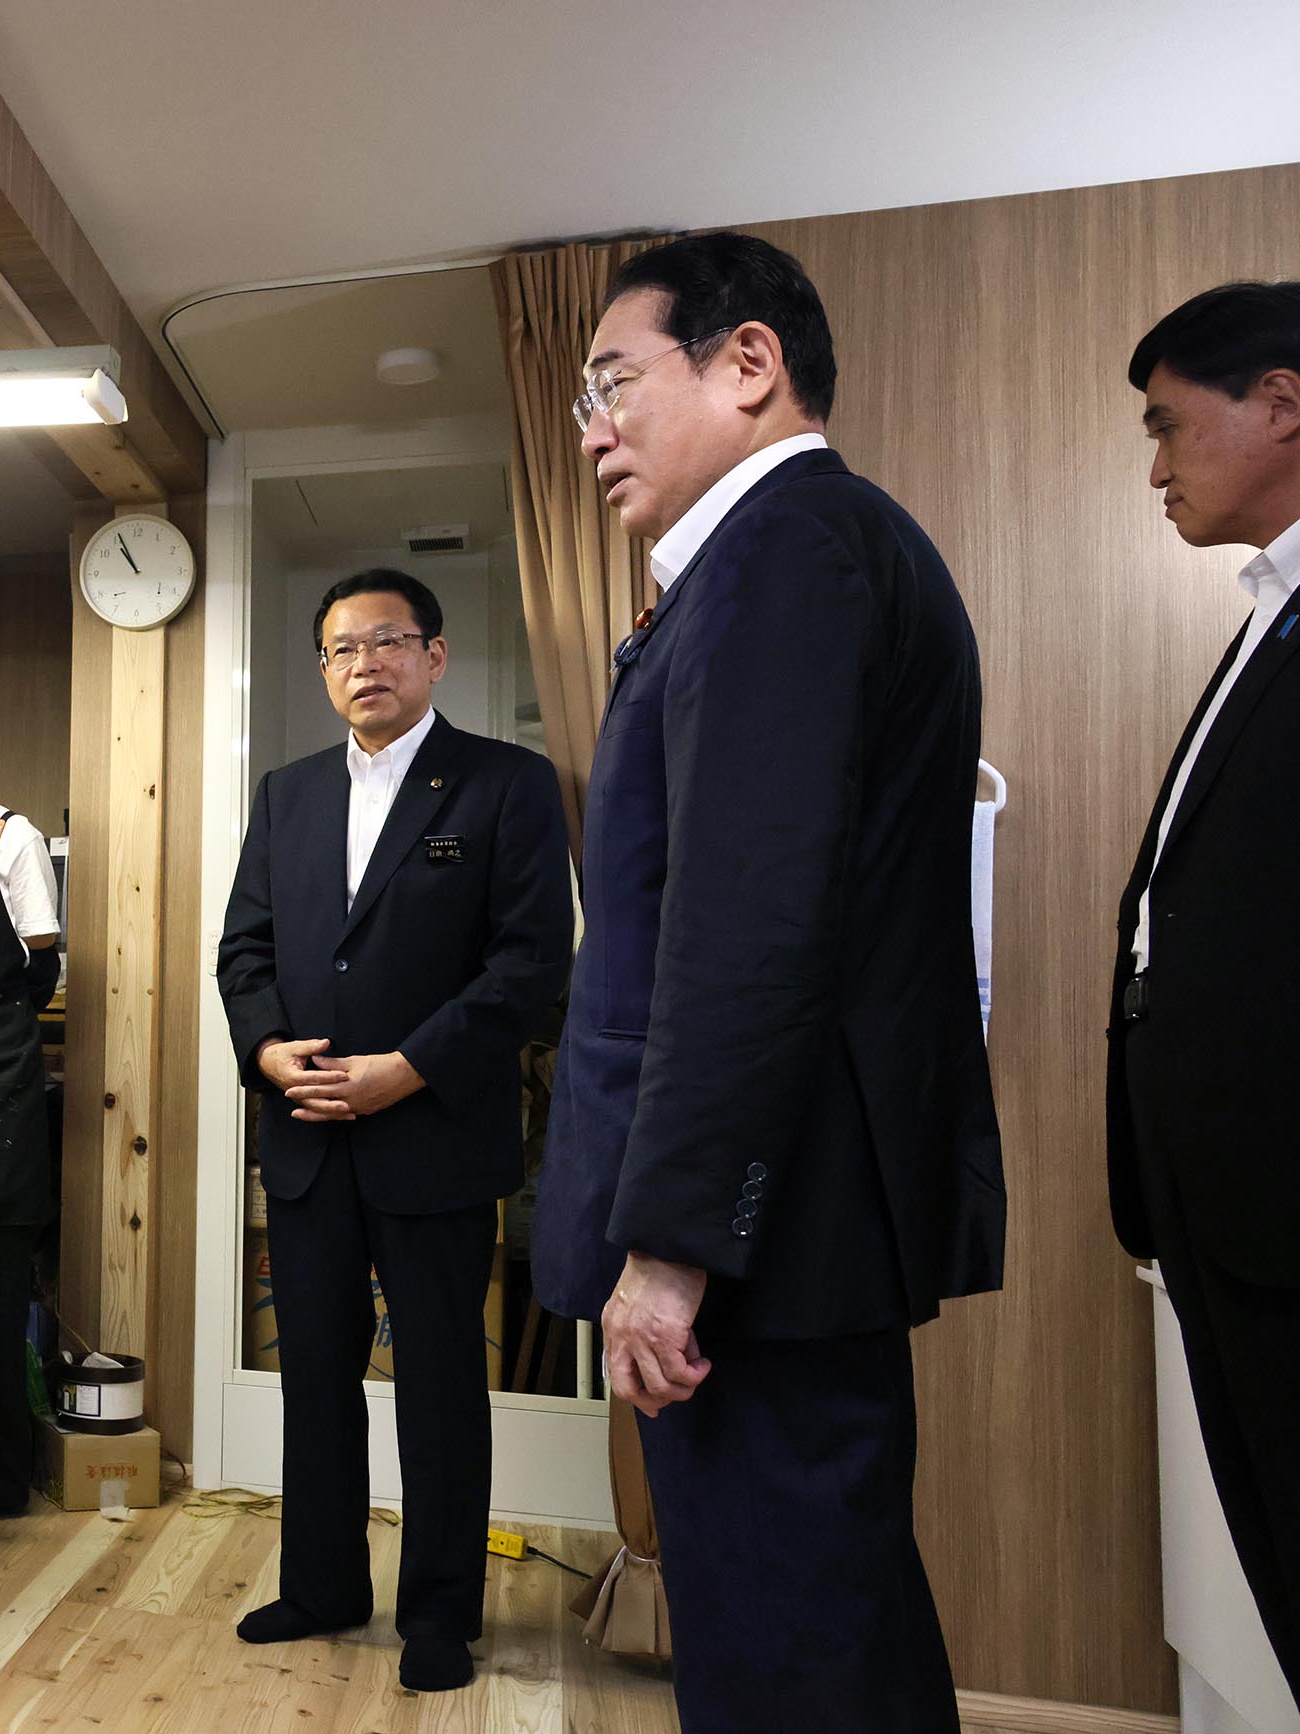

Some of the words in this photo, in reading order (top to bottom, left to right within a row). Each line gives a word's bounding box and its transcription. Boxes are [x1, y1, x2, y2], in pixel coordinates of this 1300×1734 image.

[133, 528, 143, 537] 12
[100, 549, 110, 558] 10
[170, 546, 177, 555] 2
[94, 570, 100, 578] 9
[178, 566, 183, 575] 3
[98, 591, 104, 599] 8
[172, 587, 177, 595] 4
[113, 604, 119, 614] 7
[156, 603, 162, 612] 5
[134, 609, 140, 617] 6
